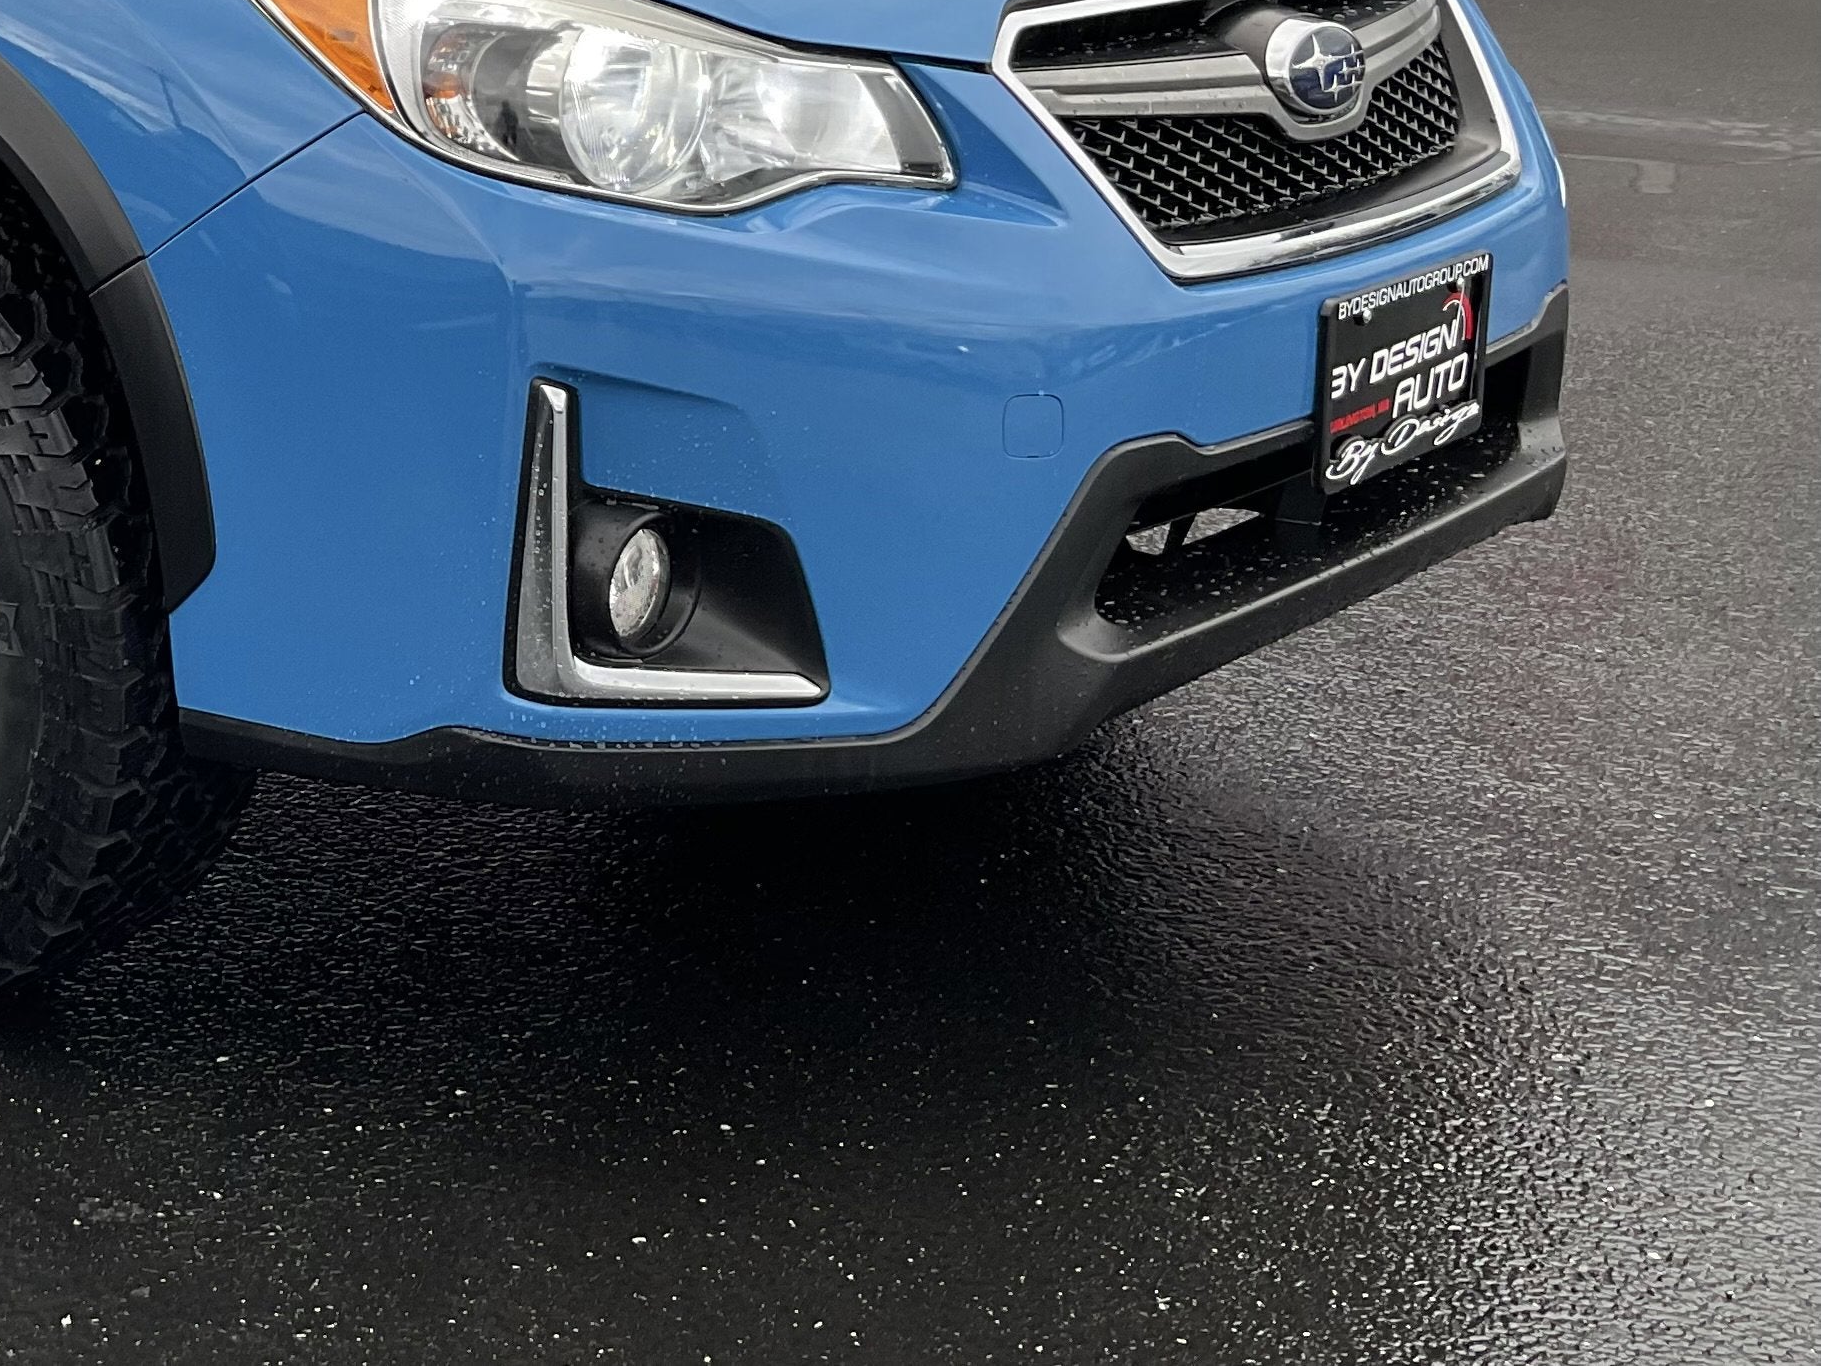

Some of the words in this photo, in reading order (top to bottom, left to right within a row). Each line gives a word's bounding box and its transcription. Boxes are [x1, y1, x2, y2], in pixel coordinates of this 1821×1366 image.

[1338, 253, 1490, 320] BYDESIGNAUTOGROUP.COM
[1331, 358, 1366, 399] BY
[1369, 318, 1459, 384] DESIGN
[1392, 352, 1468, 419] AUTO
[1325, 440, 1379, 485] By
[1381, 401, 1480, 455] Design
